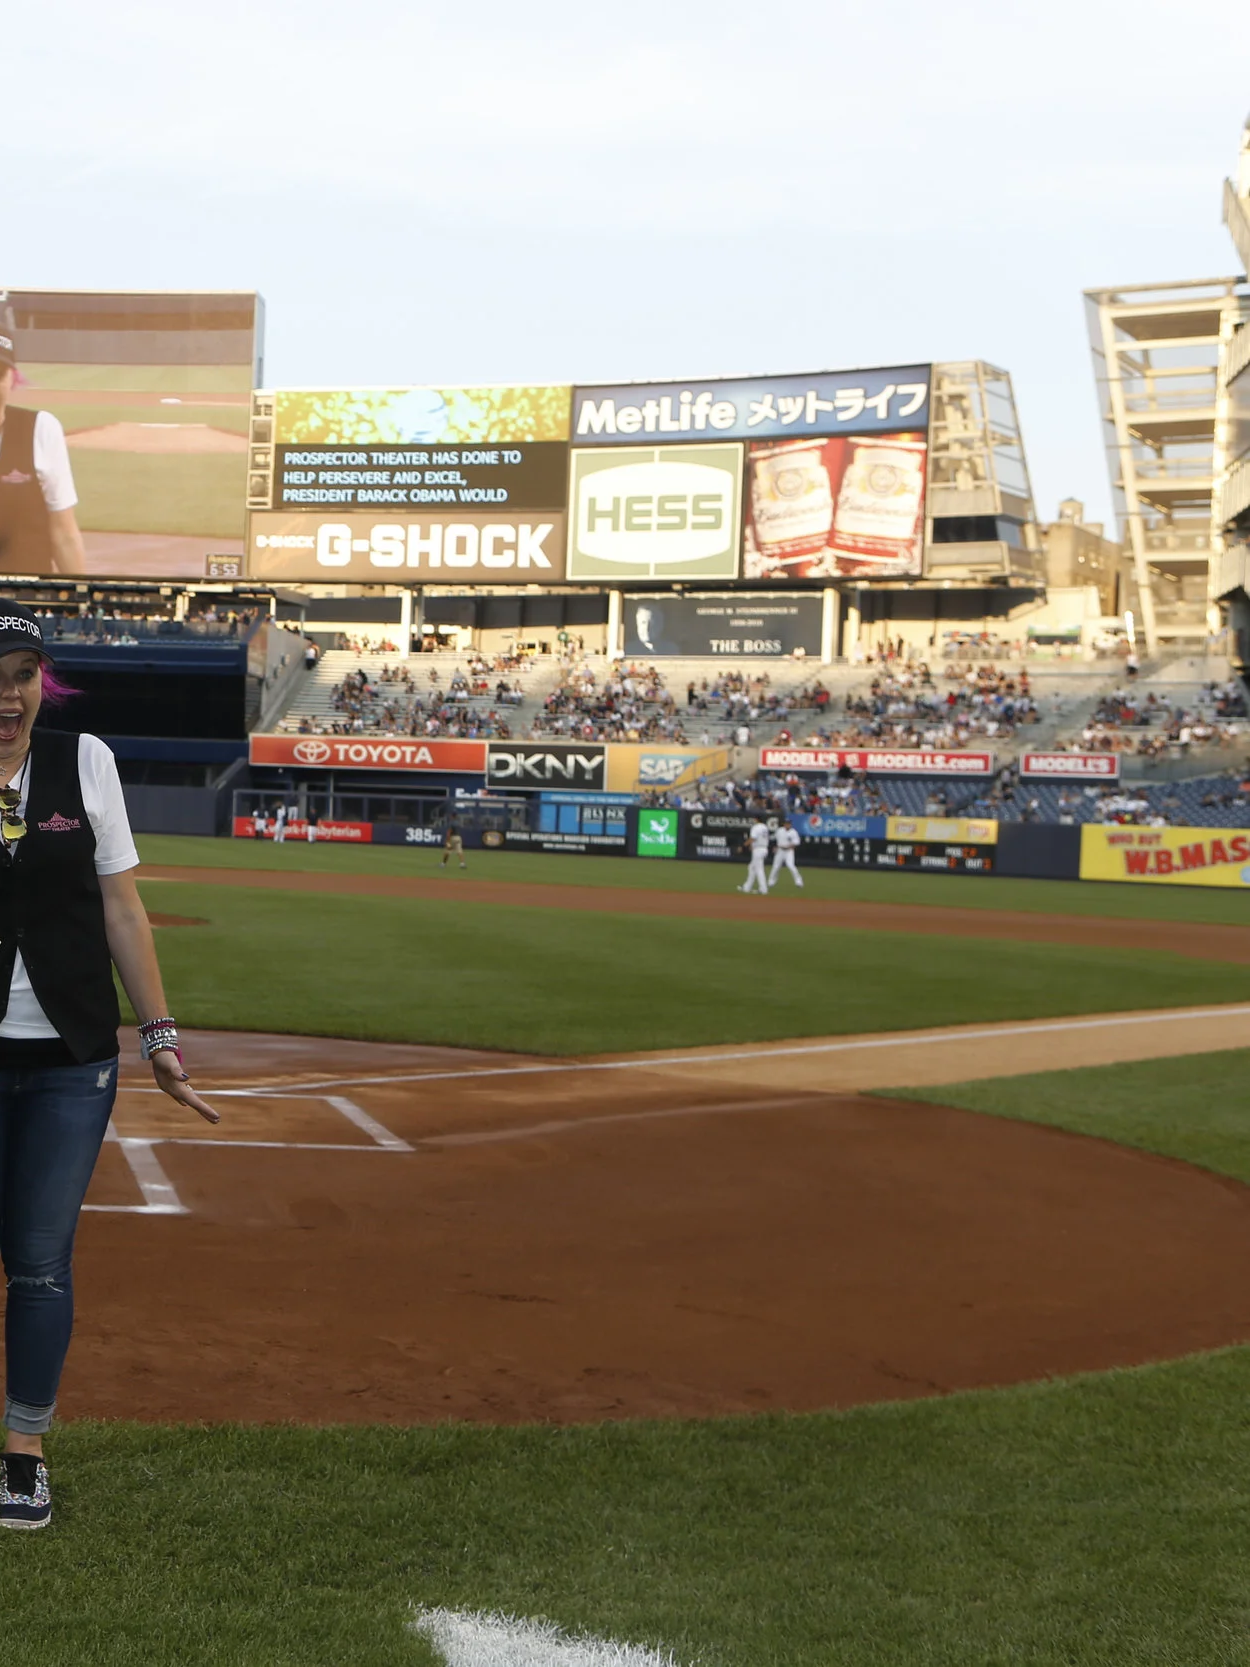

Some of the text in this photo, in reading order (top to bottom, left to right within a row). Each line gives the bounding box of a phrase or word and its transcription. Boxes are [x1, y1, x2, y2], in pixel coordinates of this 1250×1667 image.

[576, 390, 738, 436] MetLife
[747, 383, 928, 427] メットライフ
[284, 450, 522, 466] PROSPECTOR THEATER HAS DONE TO
[283, 471, 468, 486] HELP PERSEVERE AND EXCEL,
[282, 488, 508, 502] PRESIDENT BARACK OBAMA WOULD
[587, 493, 724, 533] HESS
[316, 523, 554, 569] G-SHOCK
[709, 639, 782, 654] THE BOSS
[334, 743, 434, 764] TOYOTA
[765, 751, 839, 766] MODELL'S
[866, 753, 986, 771] MODELLS.com
[488, 752, 604, 780] DKNY
[640, 758, 686, 780] SAP
[1028, 756, 1111, 774] MODELL'S
[37, 818, 81, 829] PROSPECTOR
[823, 817, 867, 836] pepsi
